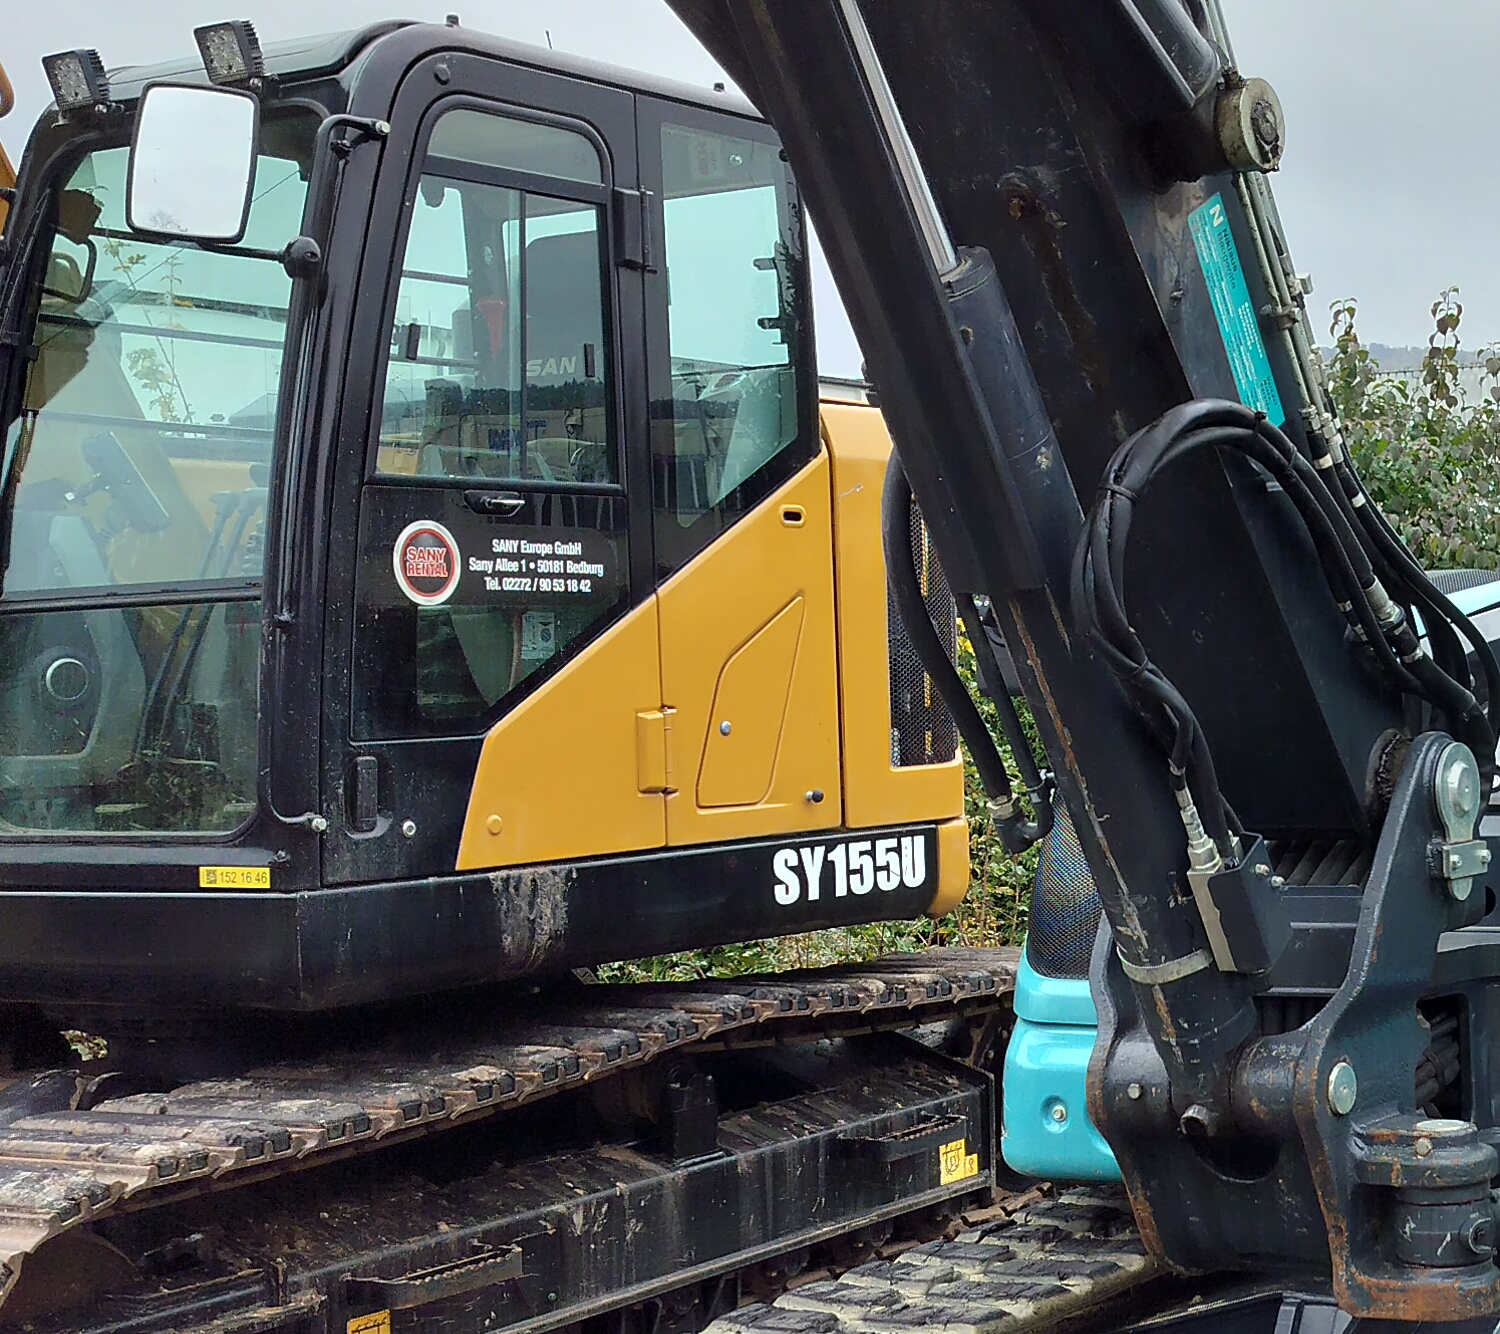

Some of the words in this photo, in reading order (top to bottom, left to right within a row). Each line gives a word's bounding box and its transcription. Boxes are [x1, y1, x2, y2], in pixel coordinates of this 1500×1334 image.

[1222, 228, 1238, 272] Niklaus
[406, 546, 447, 562] SANY
[492, 539, 519, 554] SANY
[520, 540, 553, 557] Europe
[554, 541, 582, 555] GmbH
[406, 562, 449, 577] RENTAL
[468, 557, 493, 574] Sany
[495, 558, 519, 572] Allee
[520, 559, 527, 572] 1
[537, 559, 564, 573] 50181
[566, 560, 604, 577] Bedburg
[484, 576, 501, 590] Tel.
[502, 577, 531, 591] 02272
[539, 578, 551, 591] 90
[552, 578, 565, 592] 53
[579, 579, 592, 592] 42
[220, 871, 237, 884] 152
[240, 871, 252, 884] 16
[254, 871, 267, 884] 46
[772, 835, 926, 906] SY155U
